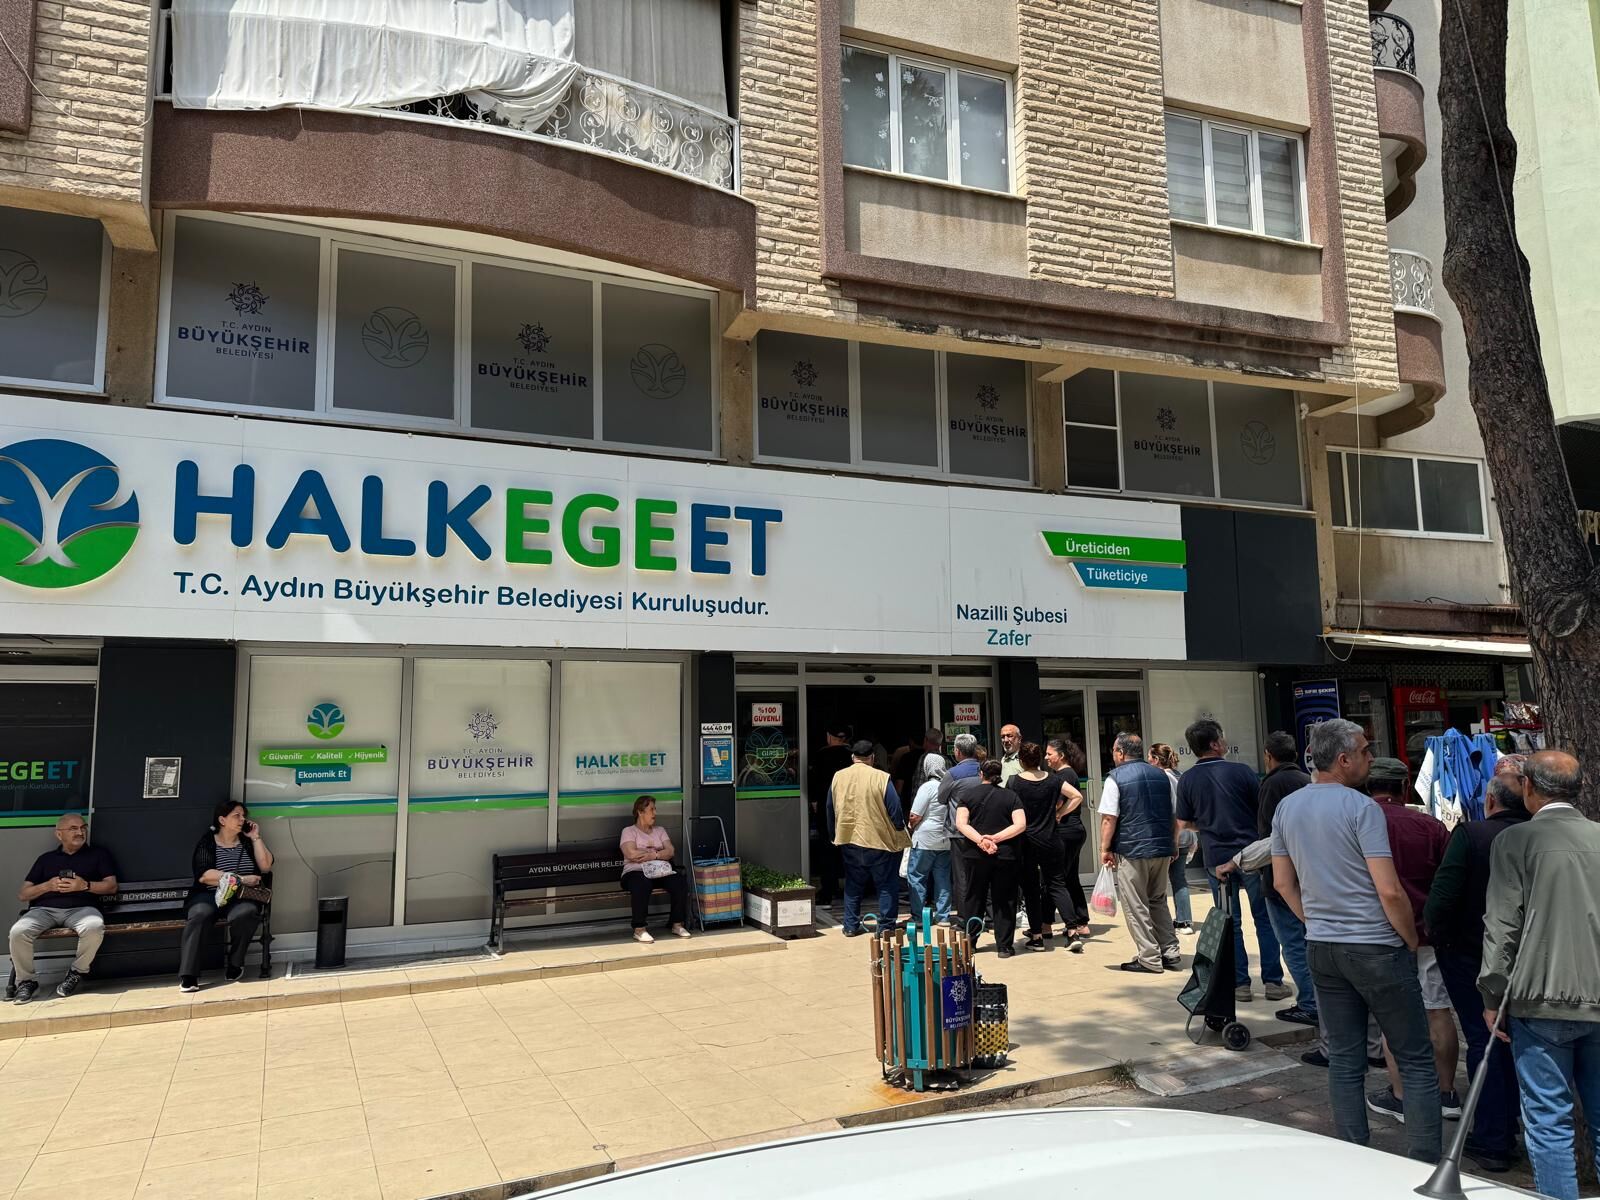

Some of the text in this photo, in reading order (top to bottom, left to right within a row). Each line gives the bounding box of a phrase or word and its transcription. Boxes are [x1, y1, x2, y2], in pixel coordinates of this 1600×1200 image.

[222, 320, 272, 334] T.C. AYDIN
[177, 326, 310, 355] BÜYÜKŞEHİR
[215, 346, 274, 360] BELEDİYESİ
[530, 360, 555, 369] AYDIN
[478, 362, 588, 388] BÜYÜKŞEHİR
[510, 381, 558, 393] BELEDİYESİ
[802, 393, 823, 402] AYDIN
[761, 397, 849, 418] BÜYÜKŞEHİR
[786, 414, 825, 424] BELEDİYESİ
[950, 419, 1027, 439] BÜYÜKŞEHİR
[1134, 440, 1201, 456] BÜYÜKŞEHİR
[173, 459, 783, 577] HALKEGEET
[1065, 538, 1131, 556] Üreticiden
[1086, 567, 1148, 583] Tüketiciye
[173, 571, 769, 618] T.C. Aydın Büyükşehir Belediyesi Kuruluşudur.
[956, 603, 1068, 625] Nazilli Şubesi
[986, 628, 1032, 646] Zafer
[757, 706, 777, 714] %100
[268, 751, 385, 761] Güvenilir Kaliteli Hijyenik
[427, 755, 534, 772] BÜYÜKŞEHİR
[575, 752, 667, 769] HALKEGEET
[298, 771, 347, 779] Ekonomik Et
[457, 770, 505, 779] BELEDİYESİ
[528, 865, 551, 875] AYDIN
[552, 862, 600, 873] BÜYÜKŞEHİR
